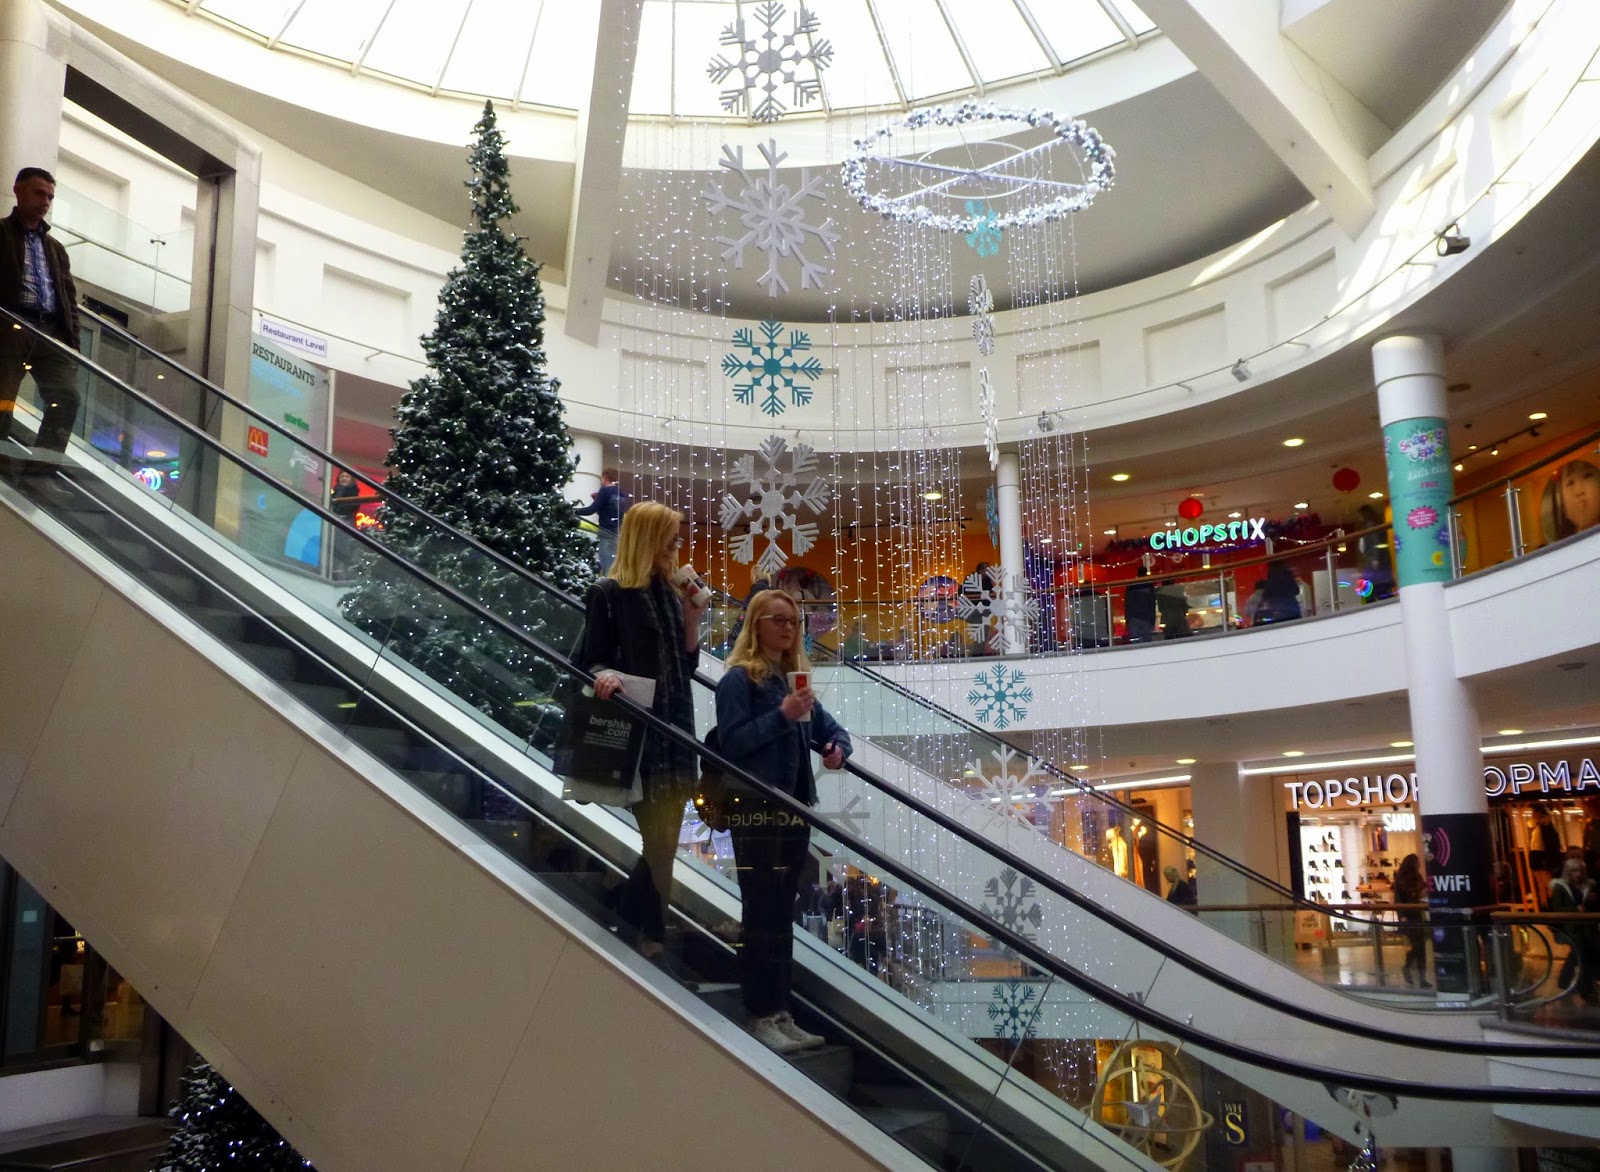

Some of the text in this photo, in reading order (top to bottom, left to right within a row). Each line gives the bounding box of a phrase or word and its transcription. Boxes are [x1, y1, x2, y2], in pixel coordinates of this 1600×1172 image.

[262, 324, 326, 352] Restaurant Level
[252, 342, 315, 386] RESTAURANTS
[1150, 517, 1266, 550] CHOPSTIX
[590, 714, 632, 730] bershka
[1225, 1112, 1246, 1144] S
